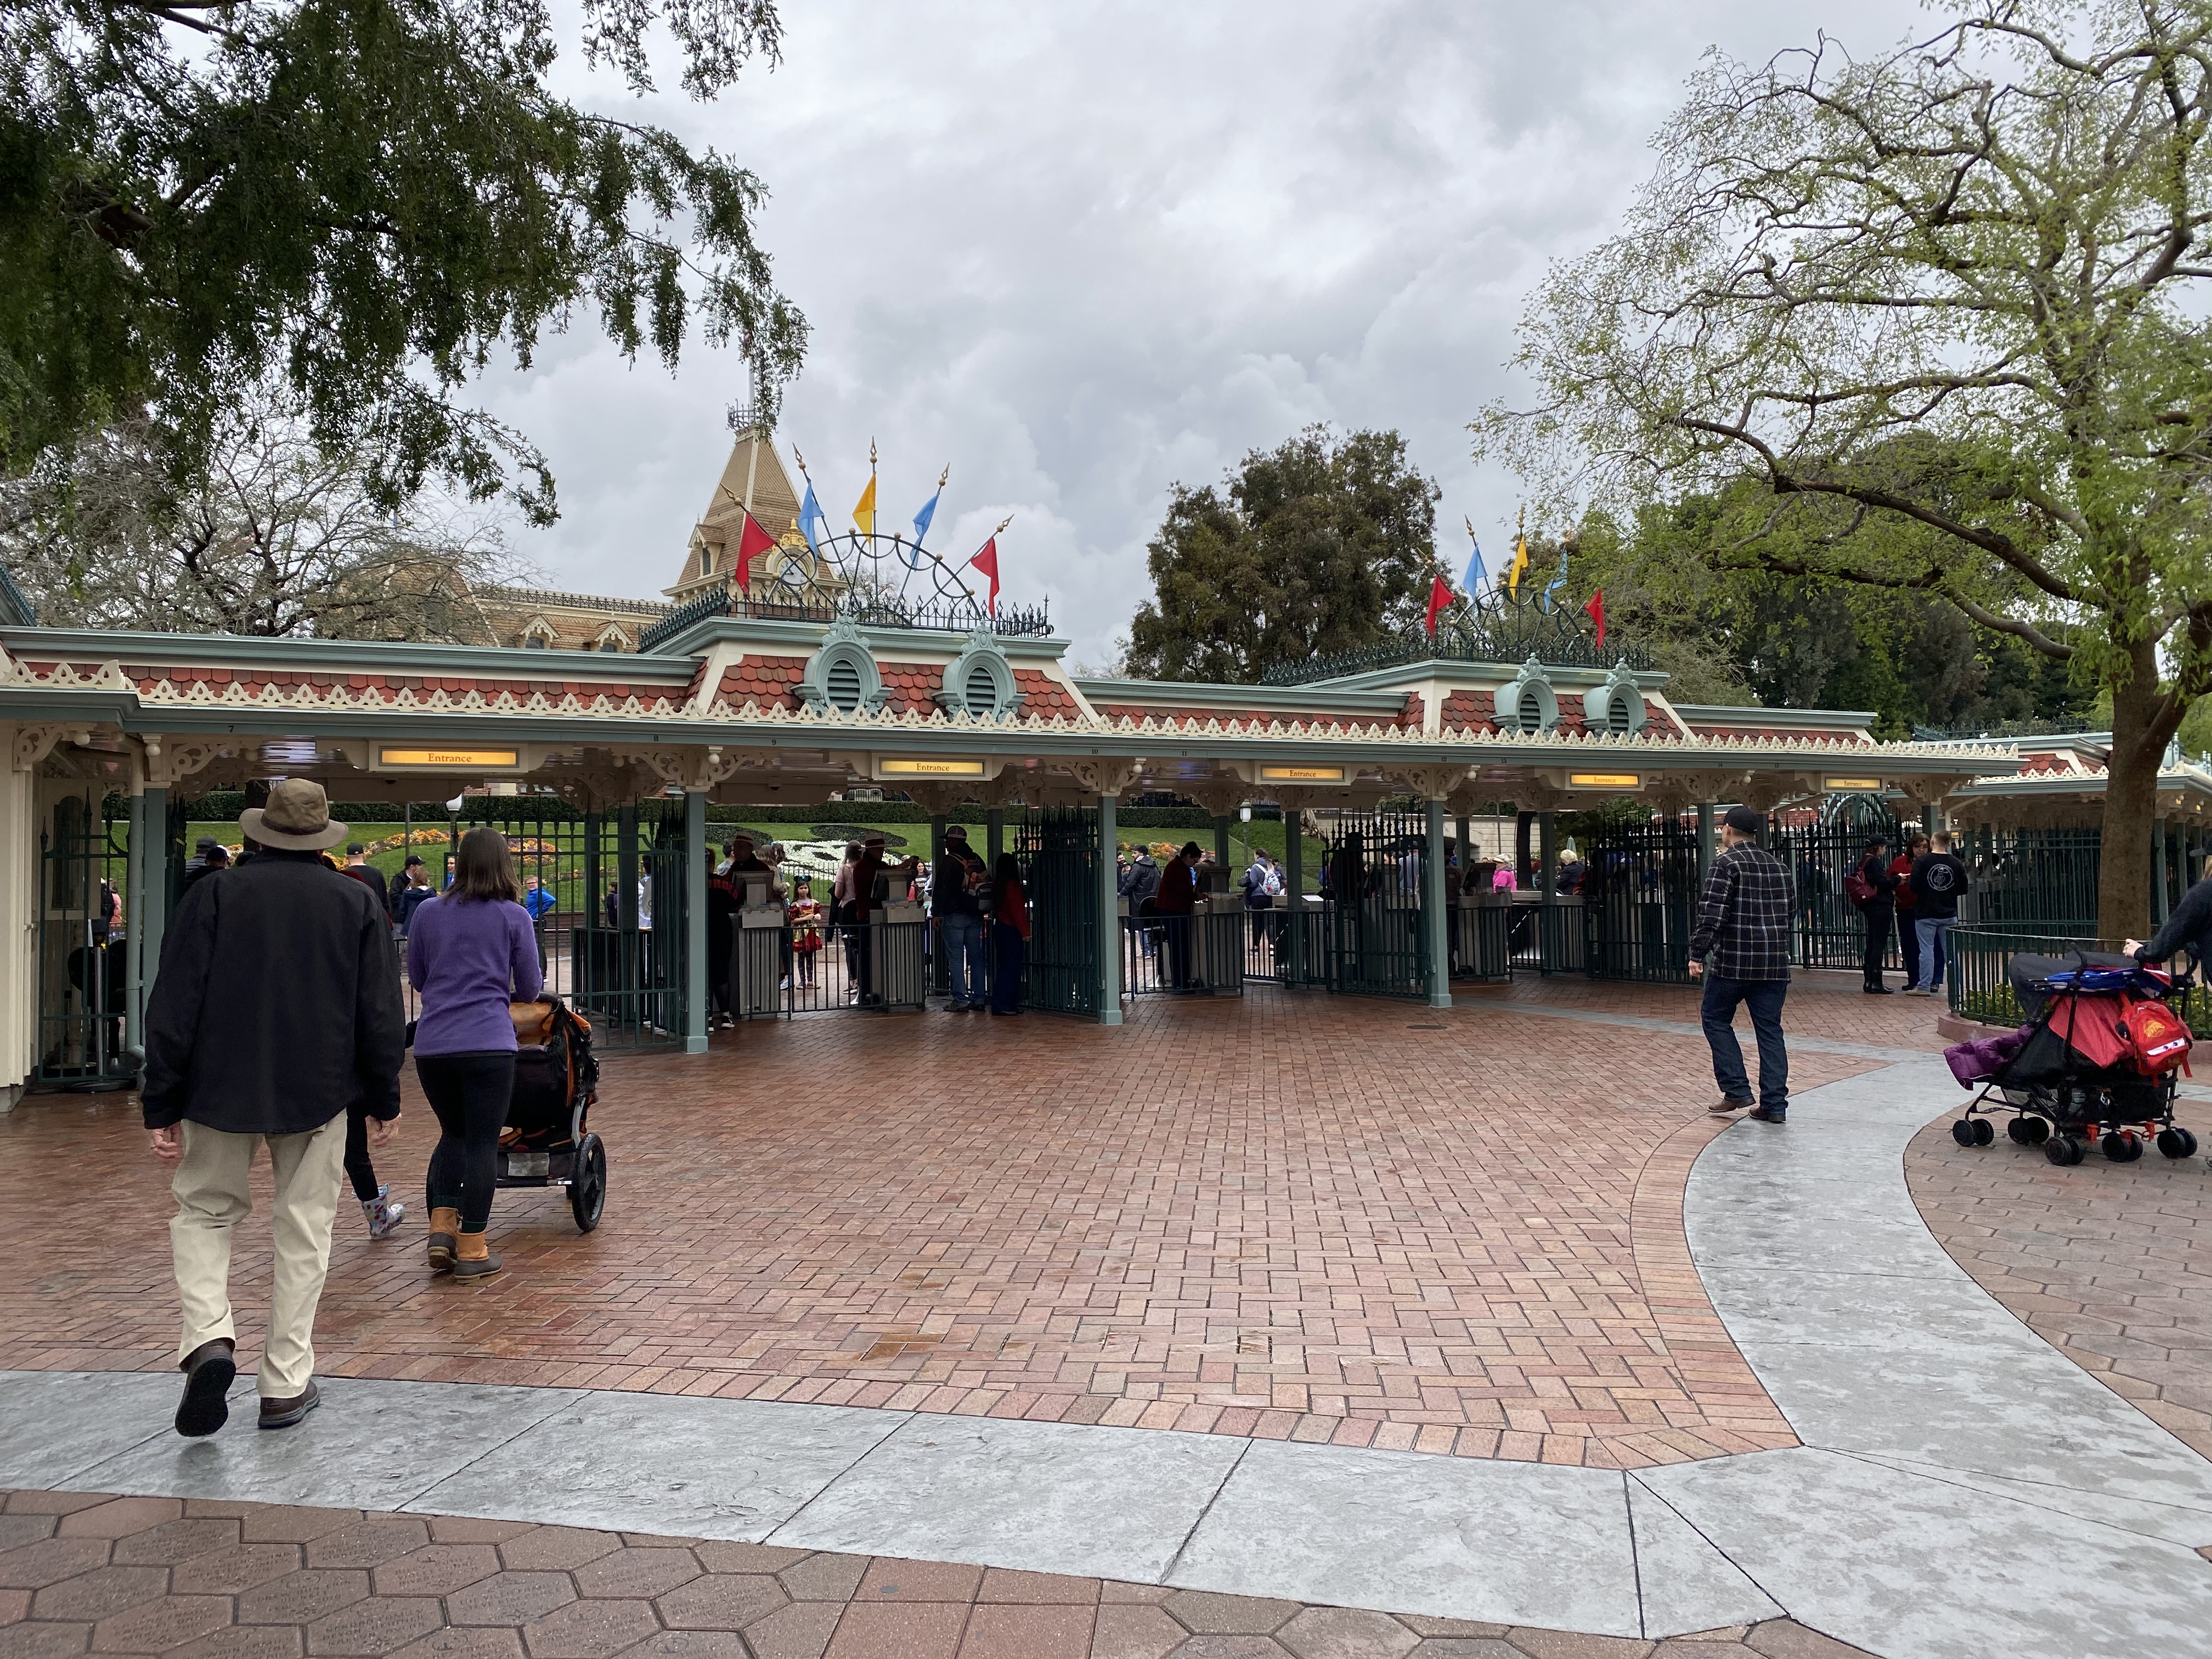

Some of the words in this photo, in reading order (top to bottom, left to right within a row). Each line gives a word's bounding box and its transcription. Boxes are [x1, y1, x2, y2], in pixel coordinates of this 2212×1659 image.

[427, 753, 472, 763] Entrance
[916, 763, 950, 771] Entrance
[257, 1591, 290, 1602] DREW
[296, 1585, 319, 1594] RON
[326, 1579, 351, 1589] ERIN
[379, 1608, 423, 1622] FAMILY
[323, 1628, 361, 1640] DEVON
